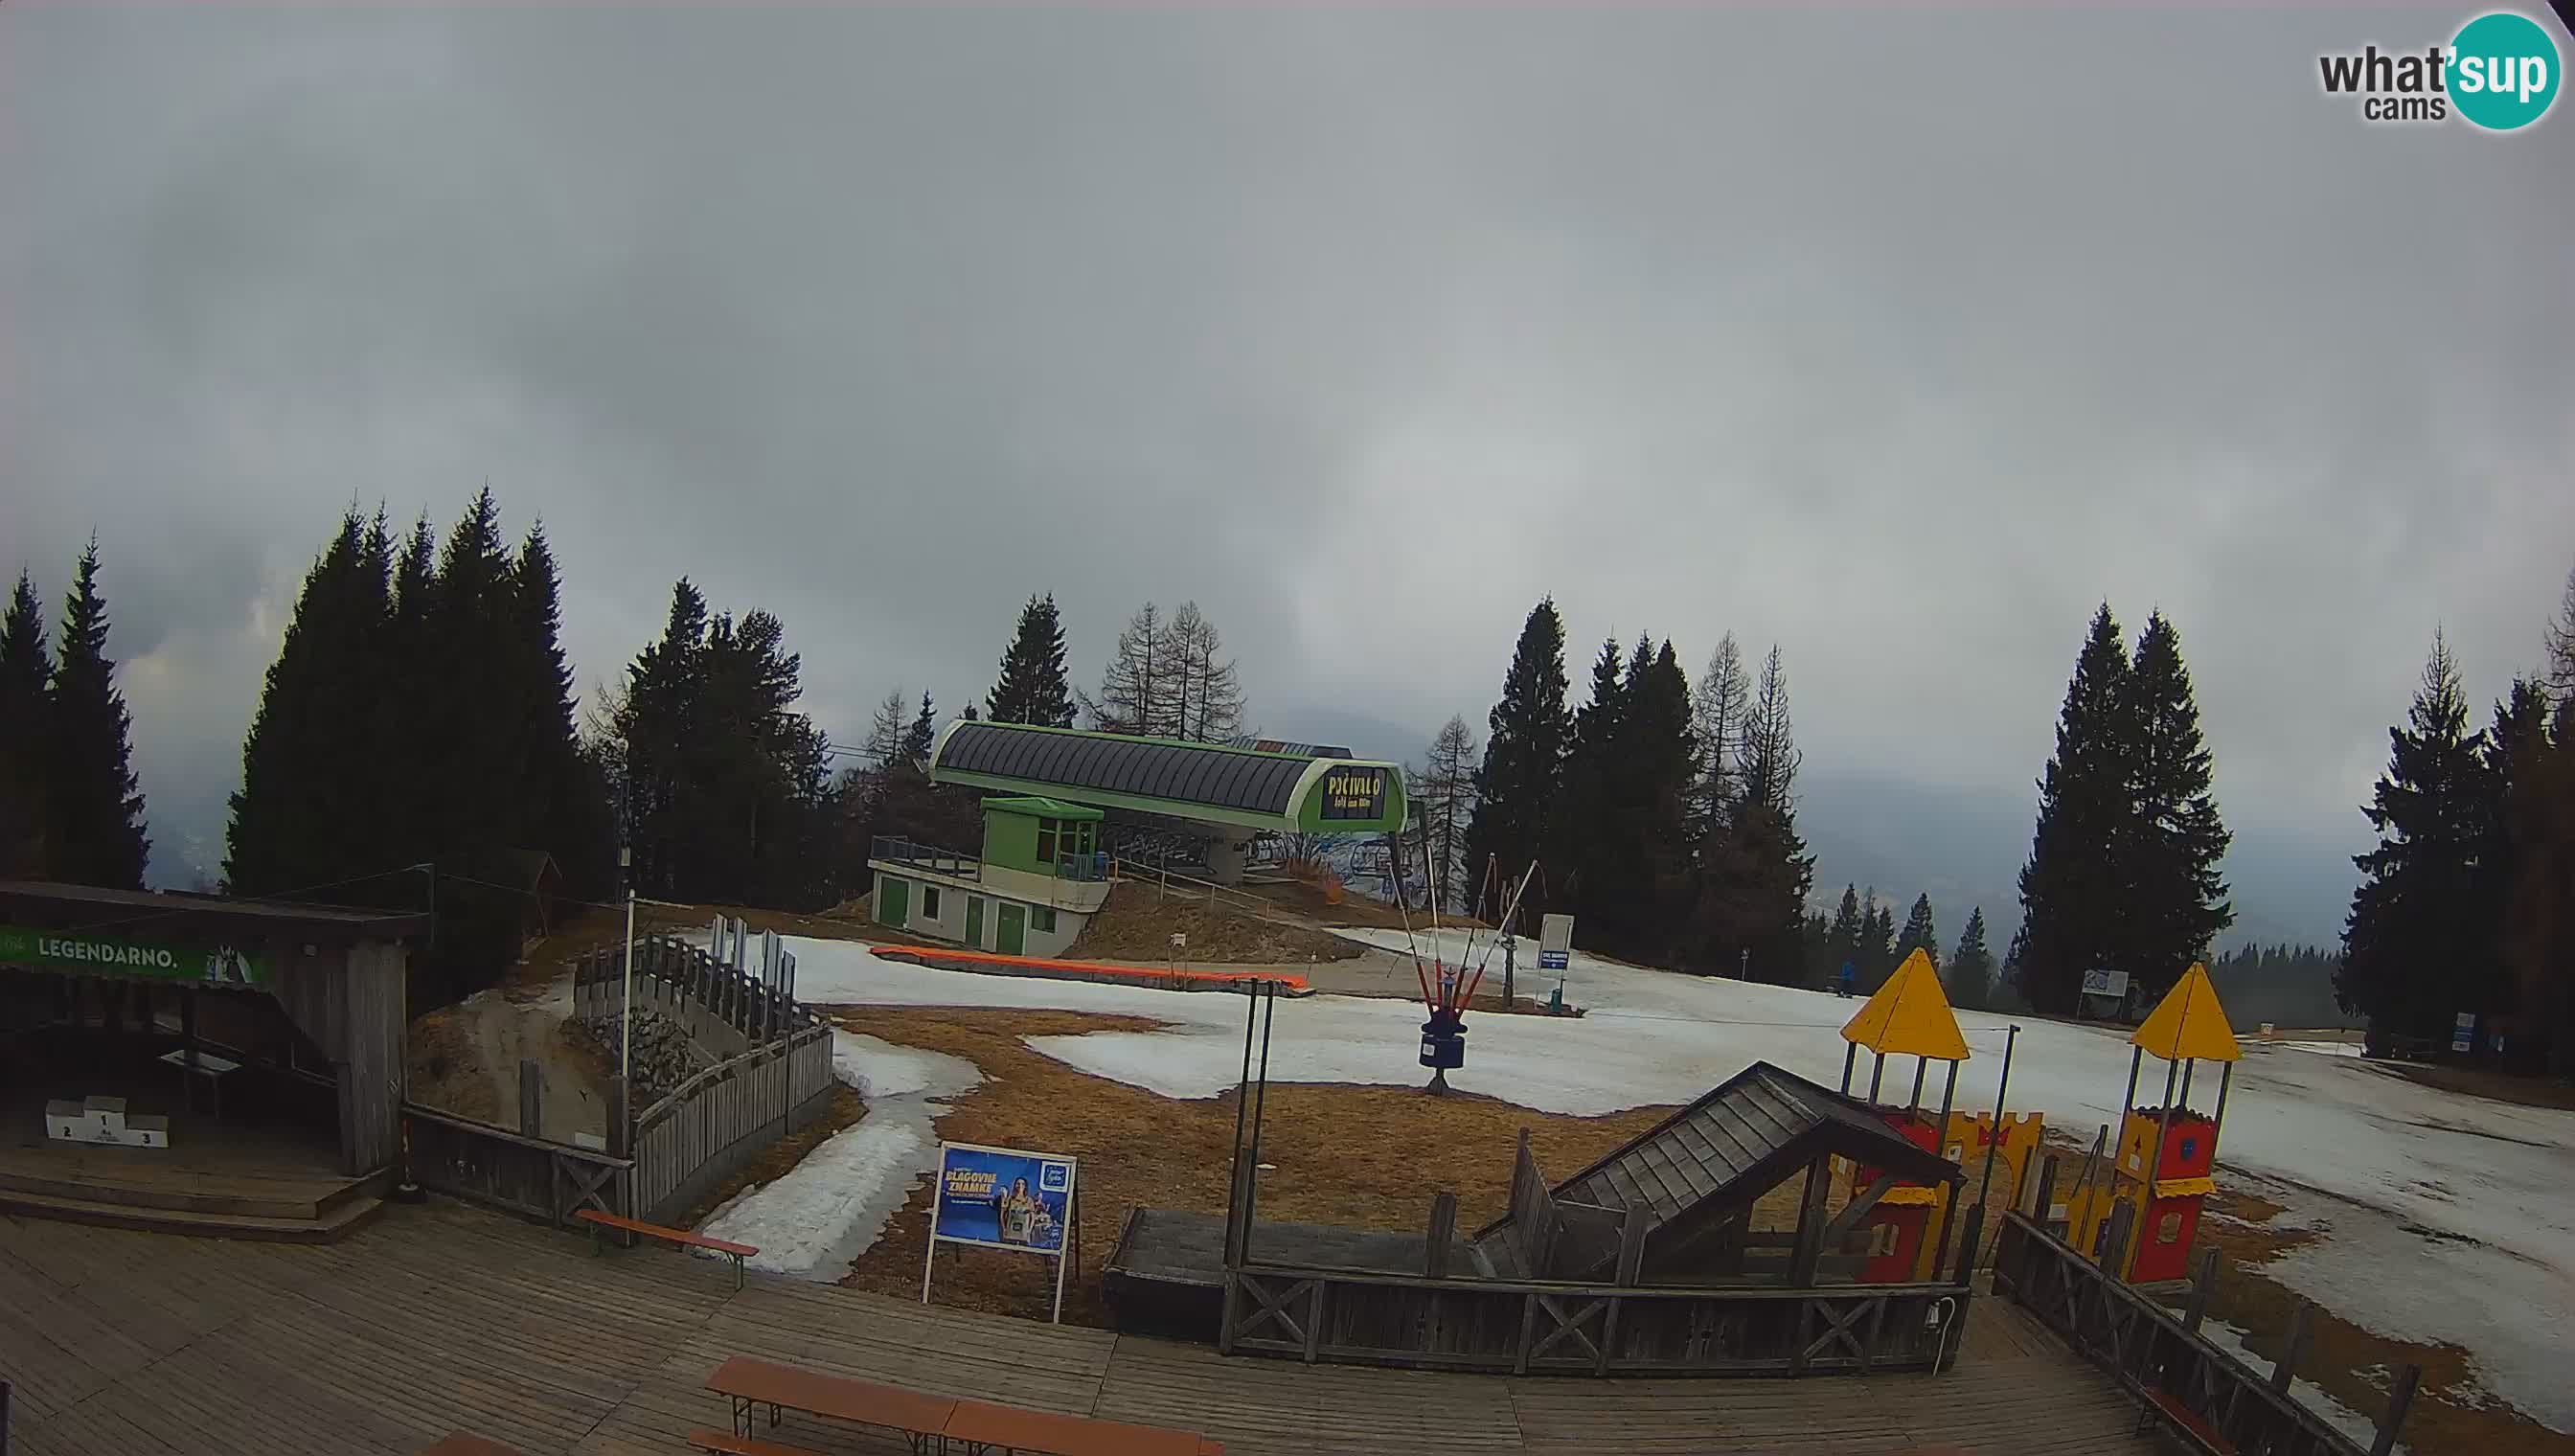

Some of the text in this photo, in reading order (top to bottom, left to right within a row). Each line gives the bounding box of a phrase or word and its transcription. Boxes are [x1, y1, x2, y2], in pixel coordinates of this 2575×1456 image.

[38, 937, 178, 968] LEGENDARNO.
[101, 1114, 107, 1126] 1
[63, 1126, 71, 1137] 2
[143, 1133, 150, 1144] 3
[946, 1172, 997, 1184] BLAGOVNE
[948, 1181, 992, 1193] ZNAMKE
